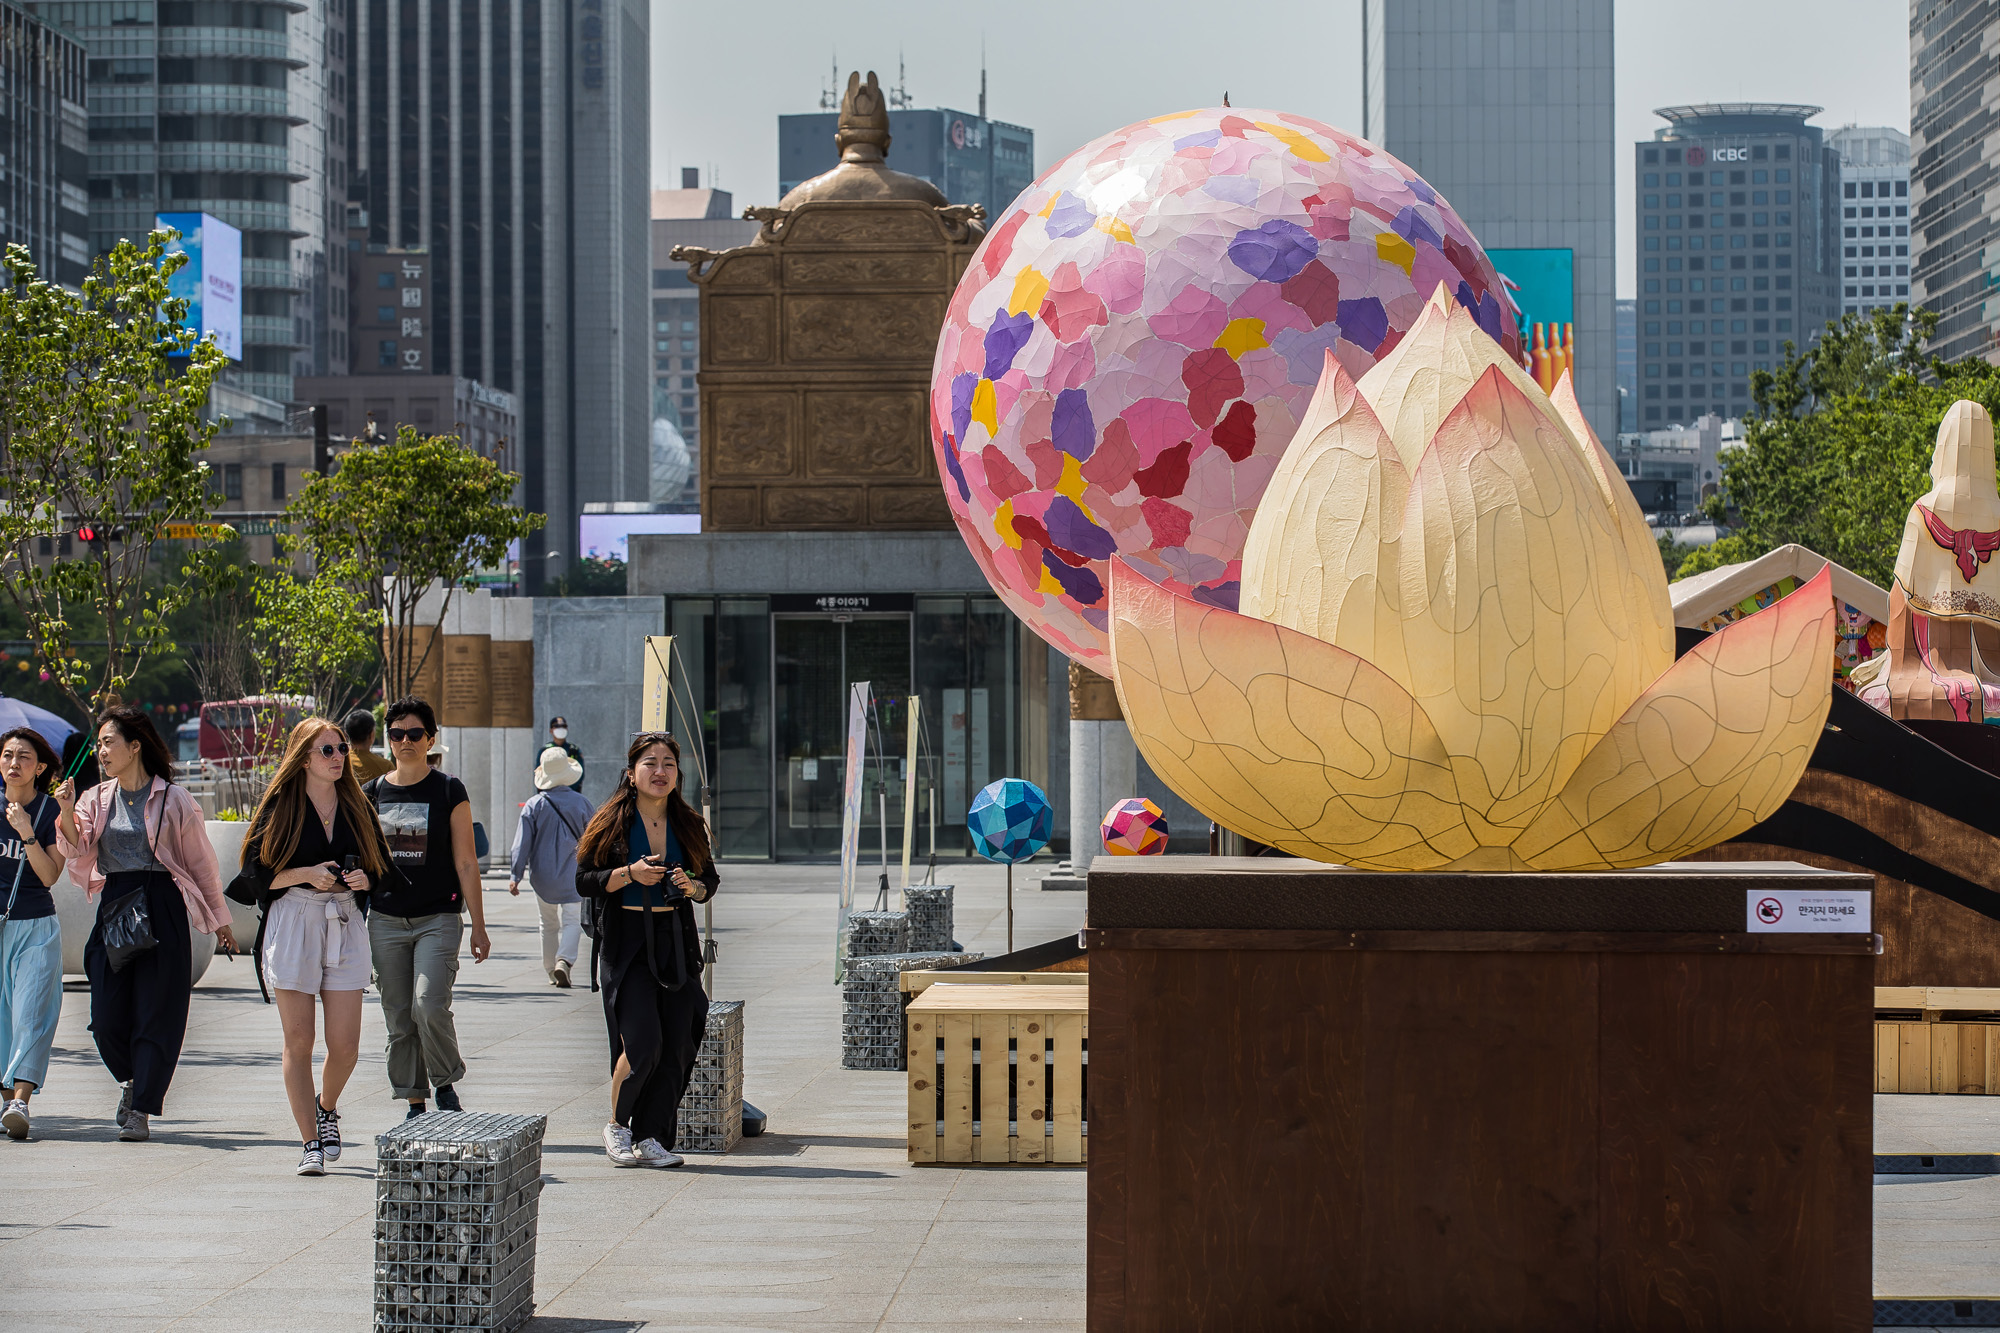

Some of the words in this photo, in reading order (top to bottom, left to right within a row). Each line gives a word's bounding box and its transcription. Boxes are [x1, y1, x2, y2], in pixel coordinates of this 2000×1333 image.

[1712, 148, 1748, 162] ICBC
[815, 597, 869, 607] 세종이야기
[1798, 905, 1826, 916] 만지지
[1828, 905, 1856, 916] 마세요
